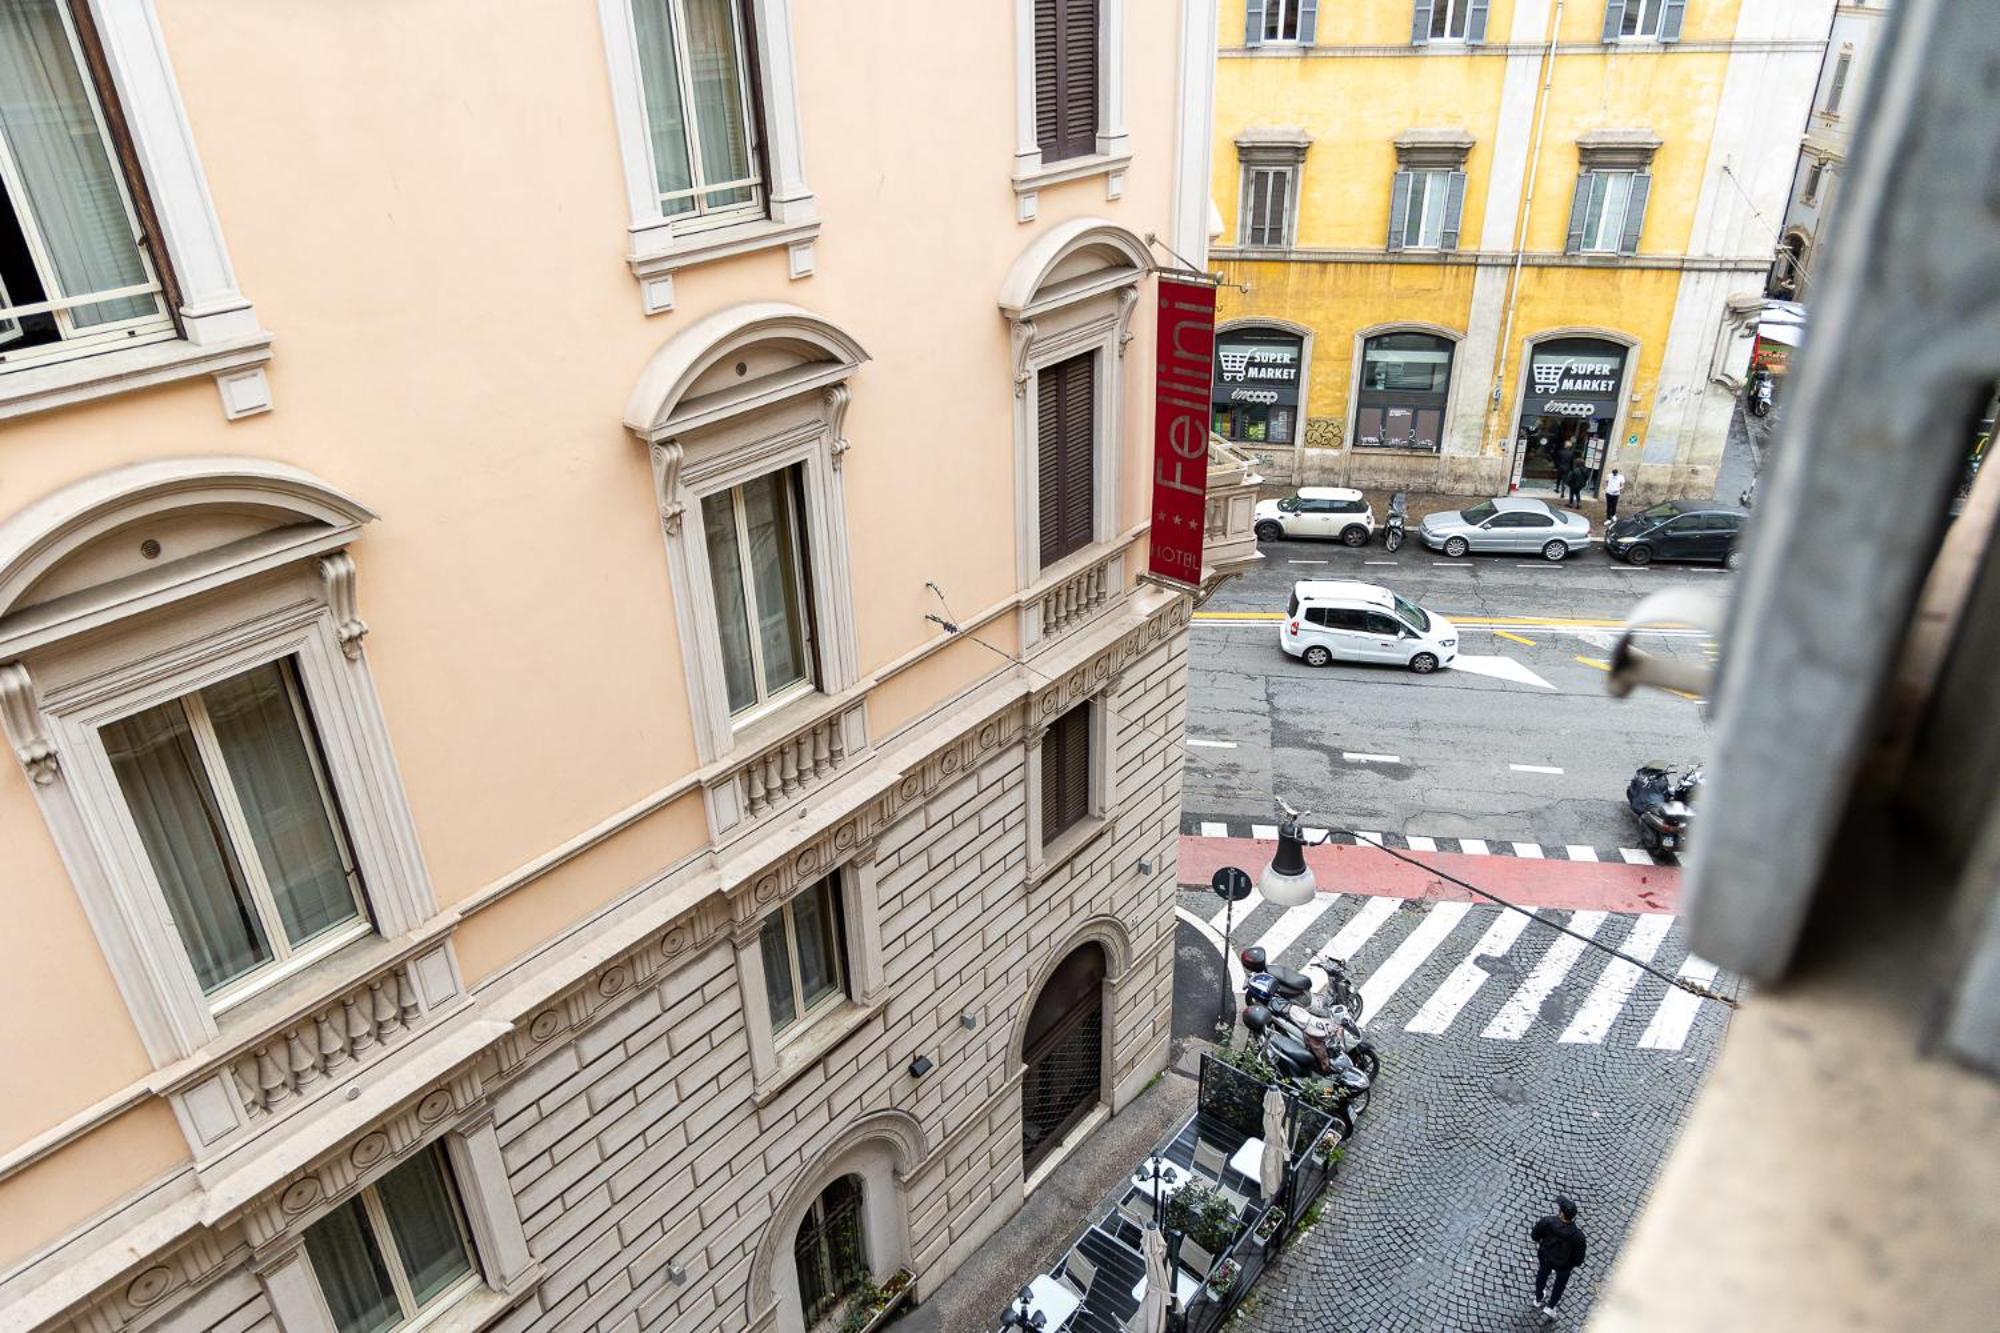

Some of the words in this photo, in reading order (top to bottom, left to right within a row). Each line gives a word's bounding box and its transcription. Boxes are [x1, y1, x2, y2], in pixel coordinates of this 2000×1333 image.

[1254, 351, 1291, 363] SUPER
[1247, 367, 1296, 379] MARKET
[1570, 363, 1611, 375] SUPER
[1561, 379, 1615, 392] MARKET
[1157, 299, 1213, 496] Fellini
[1151, 543, 1199, 570] HOTEL
